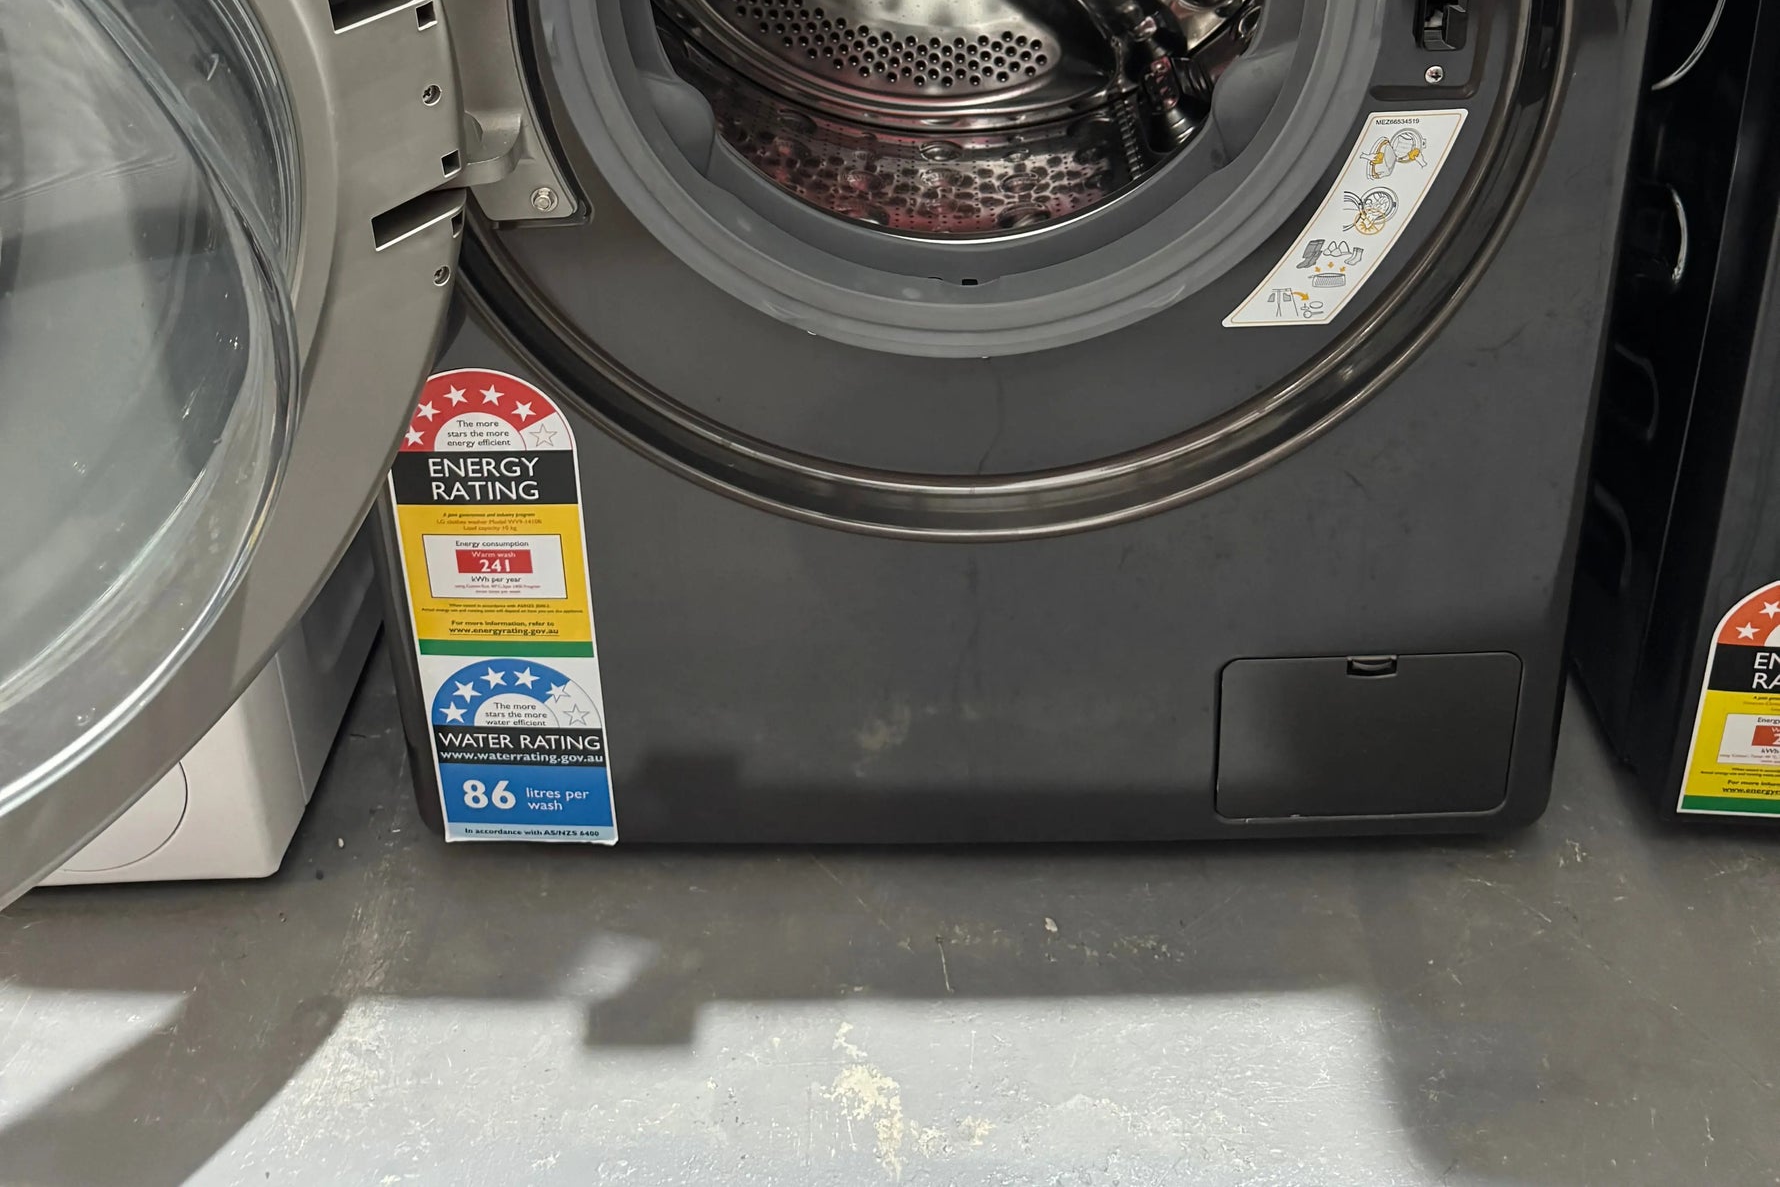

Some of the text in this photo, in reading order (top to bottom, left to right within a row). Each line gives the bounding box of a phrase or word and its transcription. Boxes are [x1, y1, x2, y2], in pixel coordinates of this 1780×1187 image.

[456, 419, 474, 428] The
[447, 440, 476, 448] energy
[428, 457, 539, 478] ENERGY
[431, 480, 540, 501] RATING
[456, 540, 480, 549] Energy
[479, 559, 510, 572] 241
[449, 627, 559, 636] www.energyrating.gov.au
[494, 702, 511, 710] The
[513, 718, 546, 726] efficient
[439, 732, 600, 750] WATER RATING
[440, 750, 604, 763] www.waterrating.gov.au
[463, 779, 516, 810] 86
[526, 787, 589, 801] litres per
[528, 800, 563, 811] wash
[465, 827, 471, 835] In
[544, 829, 578, 837] AS/NZS
